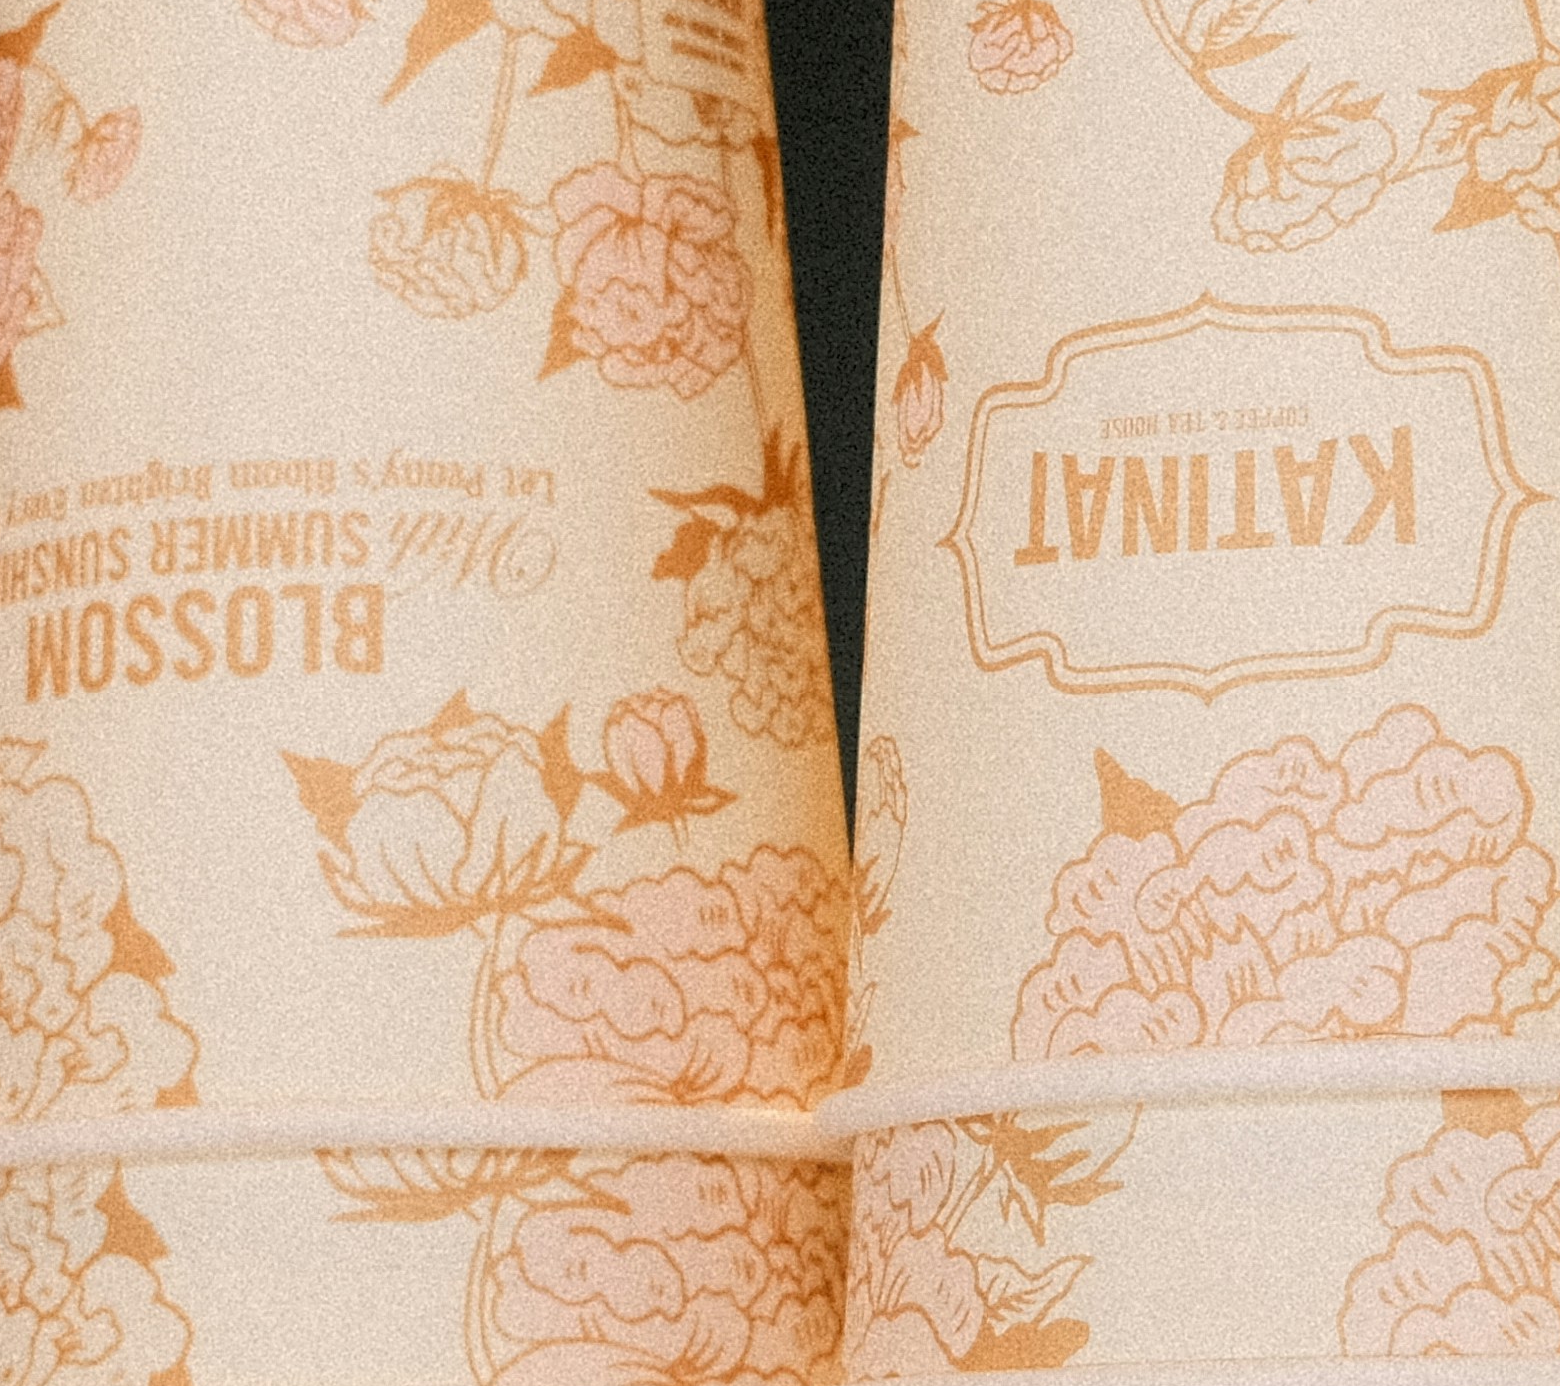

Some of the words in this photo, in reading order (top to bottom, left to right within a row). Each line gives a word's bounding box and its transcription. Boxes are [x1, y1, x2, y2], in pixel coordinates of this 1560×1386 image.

[1102, 416, 1158, 439] HOUSE
[1169, 411, 1207, 434] TEA
[80, 460, 213, 508] Brighten
[229, 459, 337, 493] Bloom
[504, 466, 555, 504] Let
[1013, 425, 1416, 566] KATINAT
[150, 513, 371, 576] SUMMER
[385, 514, 557, 598] With
[25, 583, 384, 704] BLOSSOM
